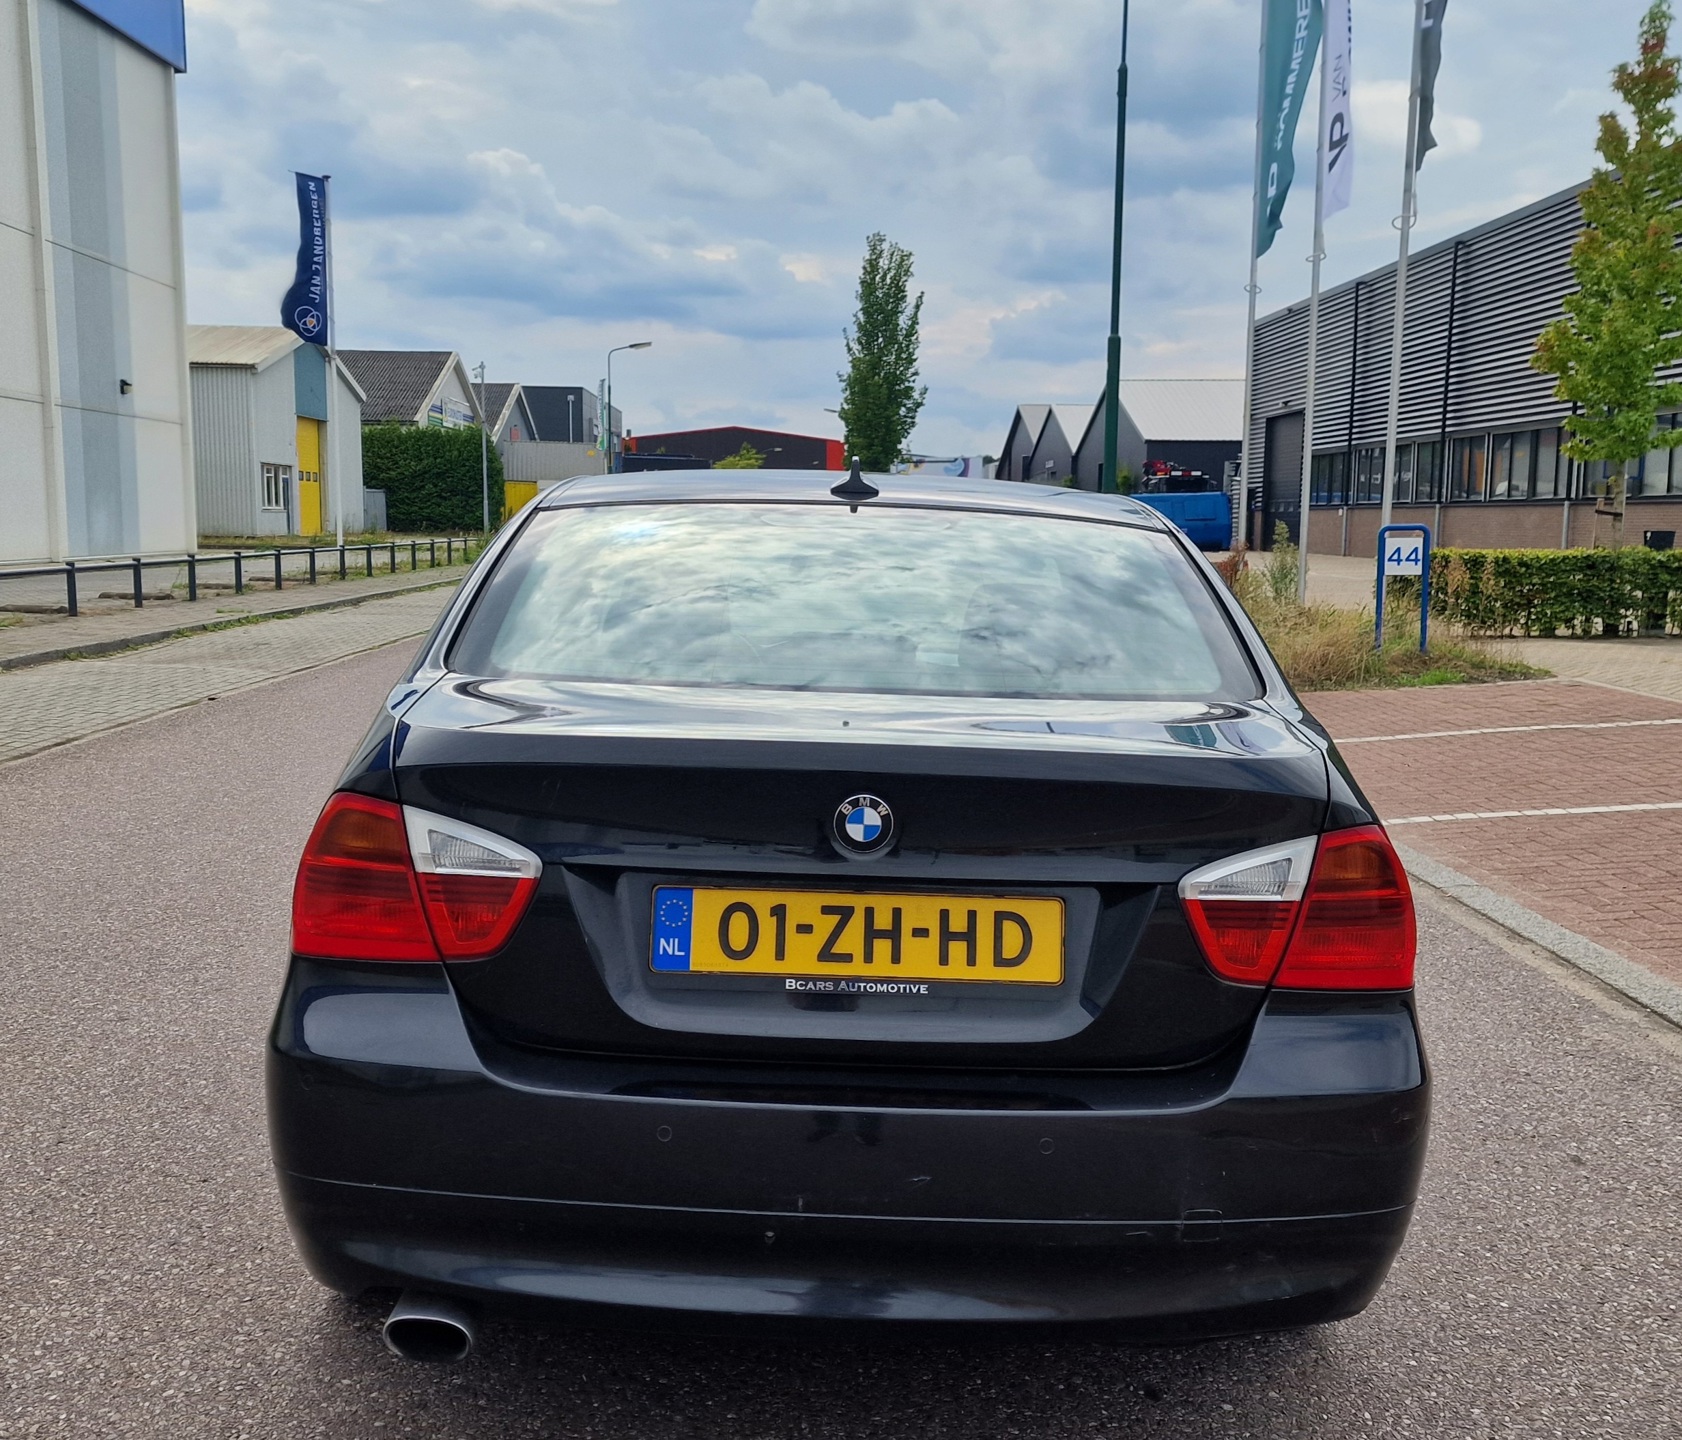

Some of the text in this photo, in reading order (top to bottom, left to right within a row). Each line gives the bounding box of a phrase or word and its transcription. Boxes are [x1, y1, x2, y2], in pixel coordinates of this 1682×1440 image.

[1332, 54, 1343, 102] VAN
[308, 275, 321, 303] JAN
[1387, 546, 1421, 566] 44
[841, 797, 889, 816] BMW
[718, 901, 1033, 968] 01-ZH-HD
[659, 938, 685, 956] NL
